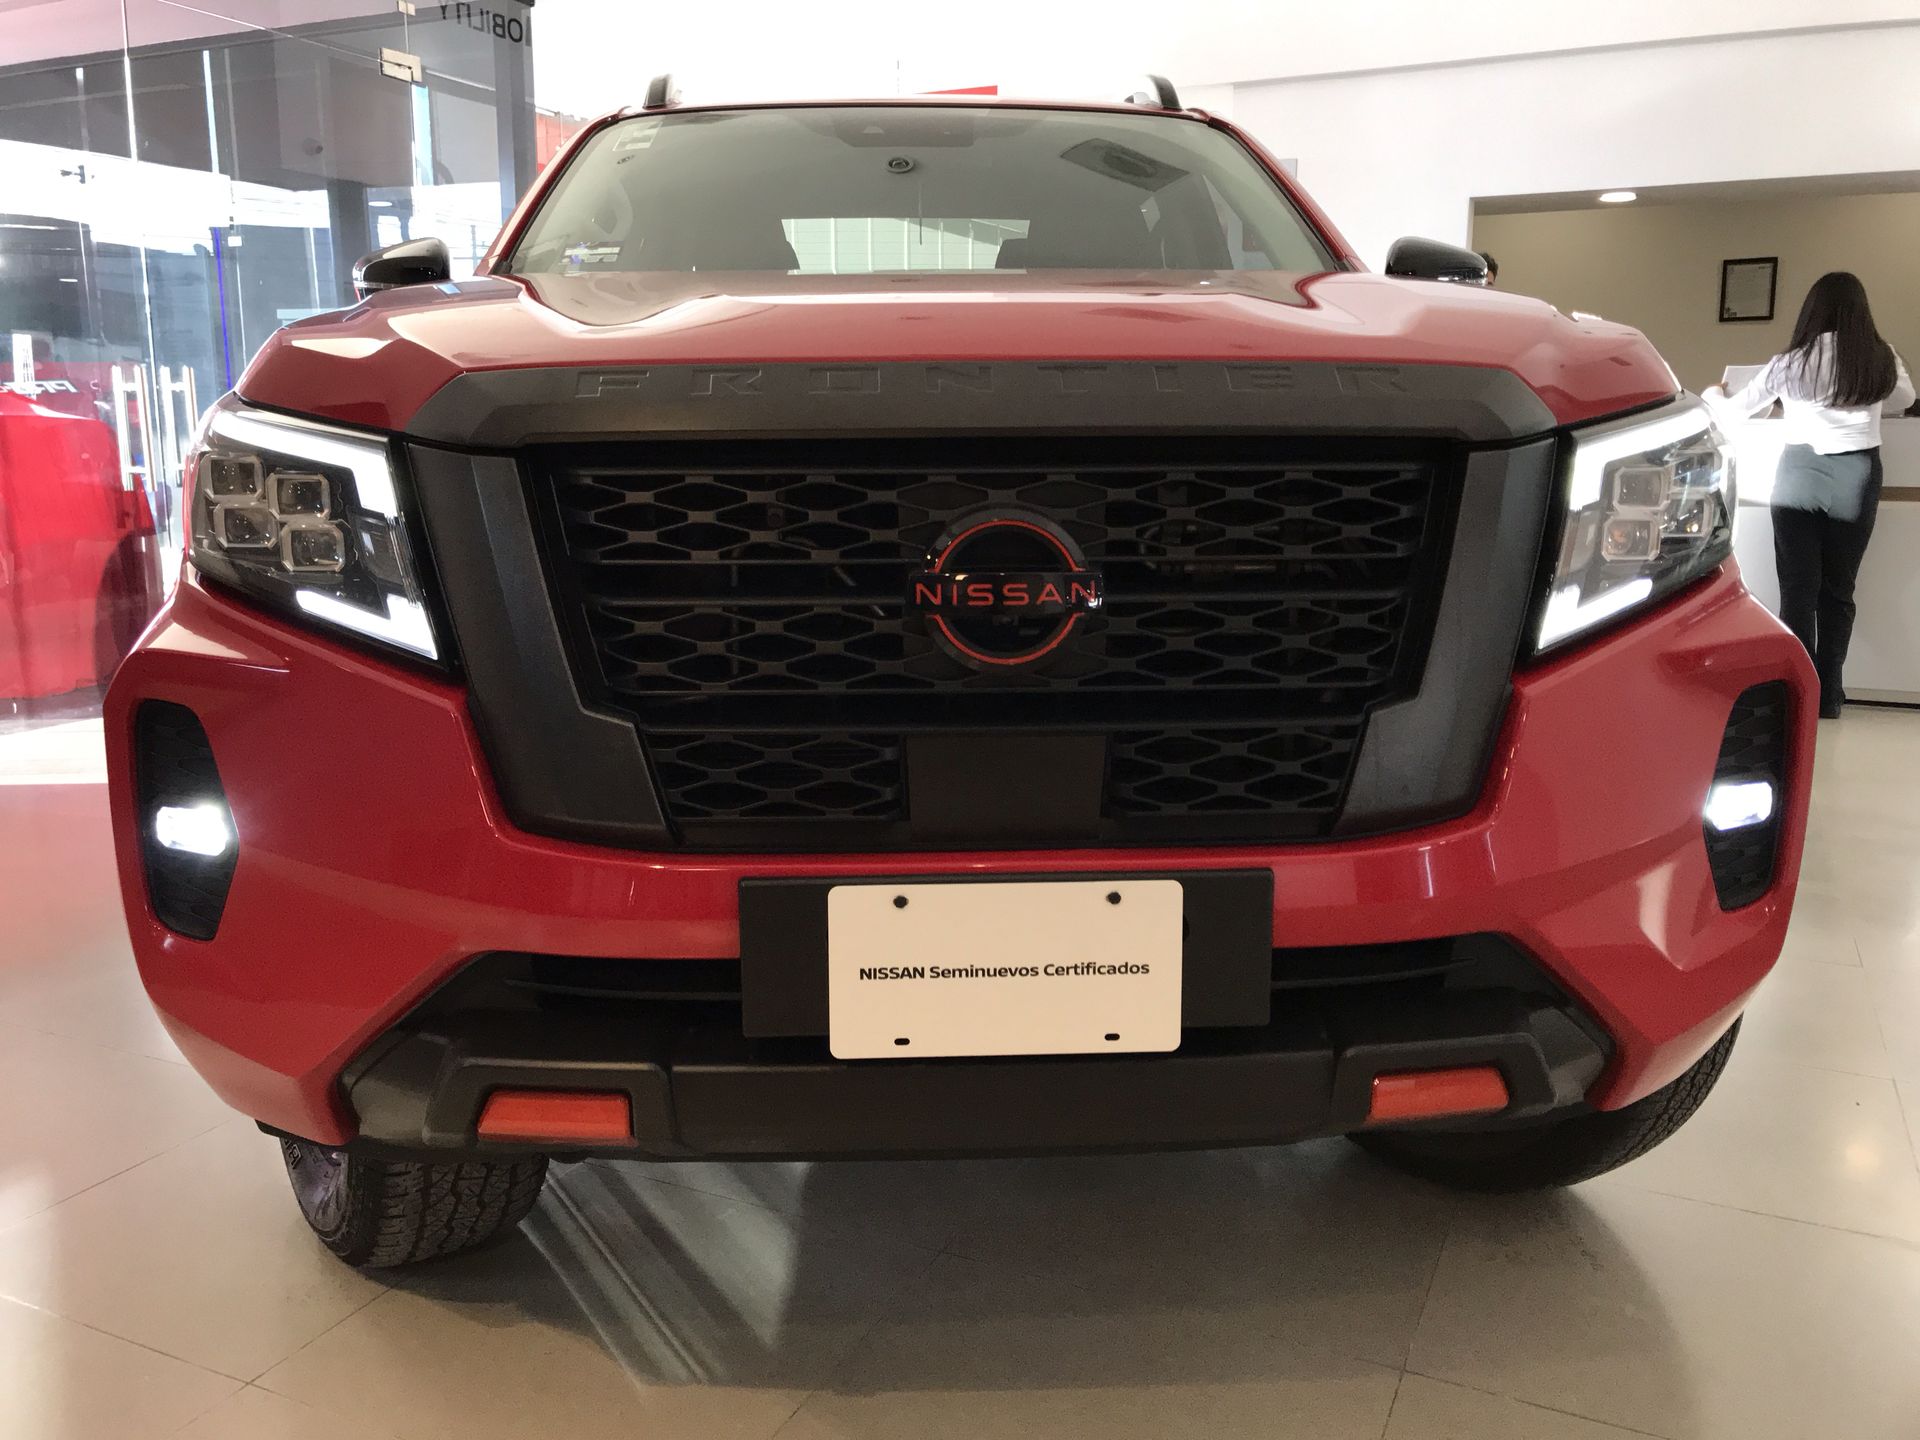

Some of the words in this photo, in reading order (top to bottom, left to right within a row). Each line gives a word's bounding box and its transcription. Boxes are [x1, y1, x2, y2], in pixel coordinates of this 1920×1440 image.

[575, 365, 1407, 398] FRONTIER
[914, 580, 1097, 606] NISSAN
[859, 966, 925, 980] NISSAN
[929, 964, 1039, 979] Seminuevos
[1043, 961, 1150, 977] Certificados
